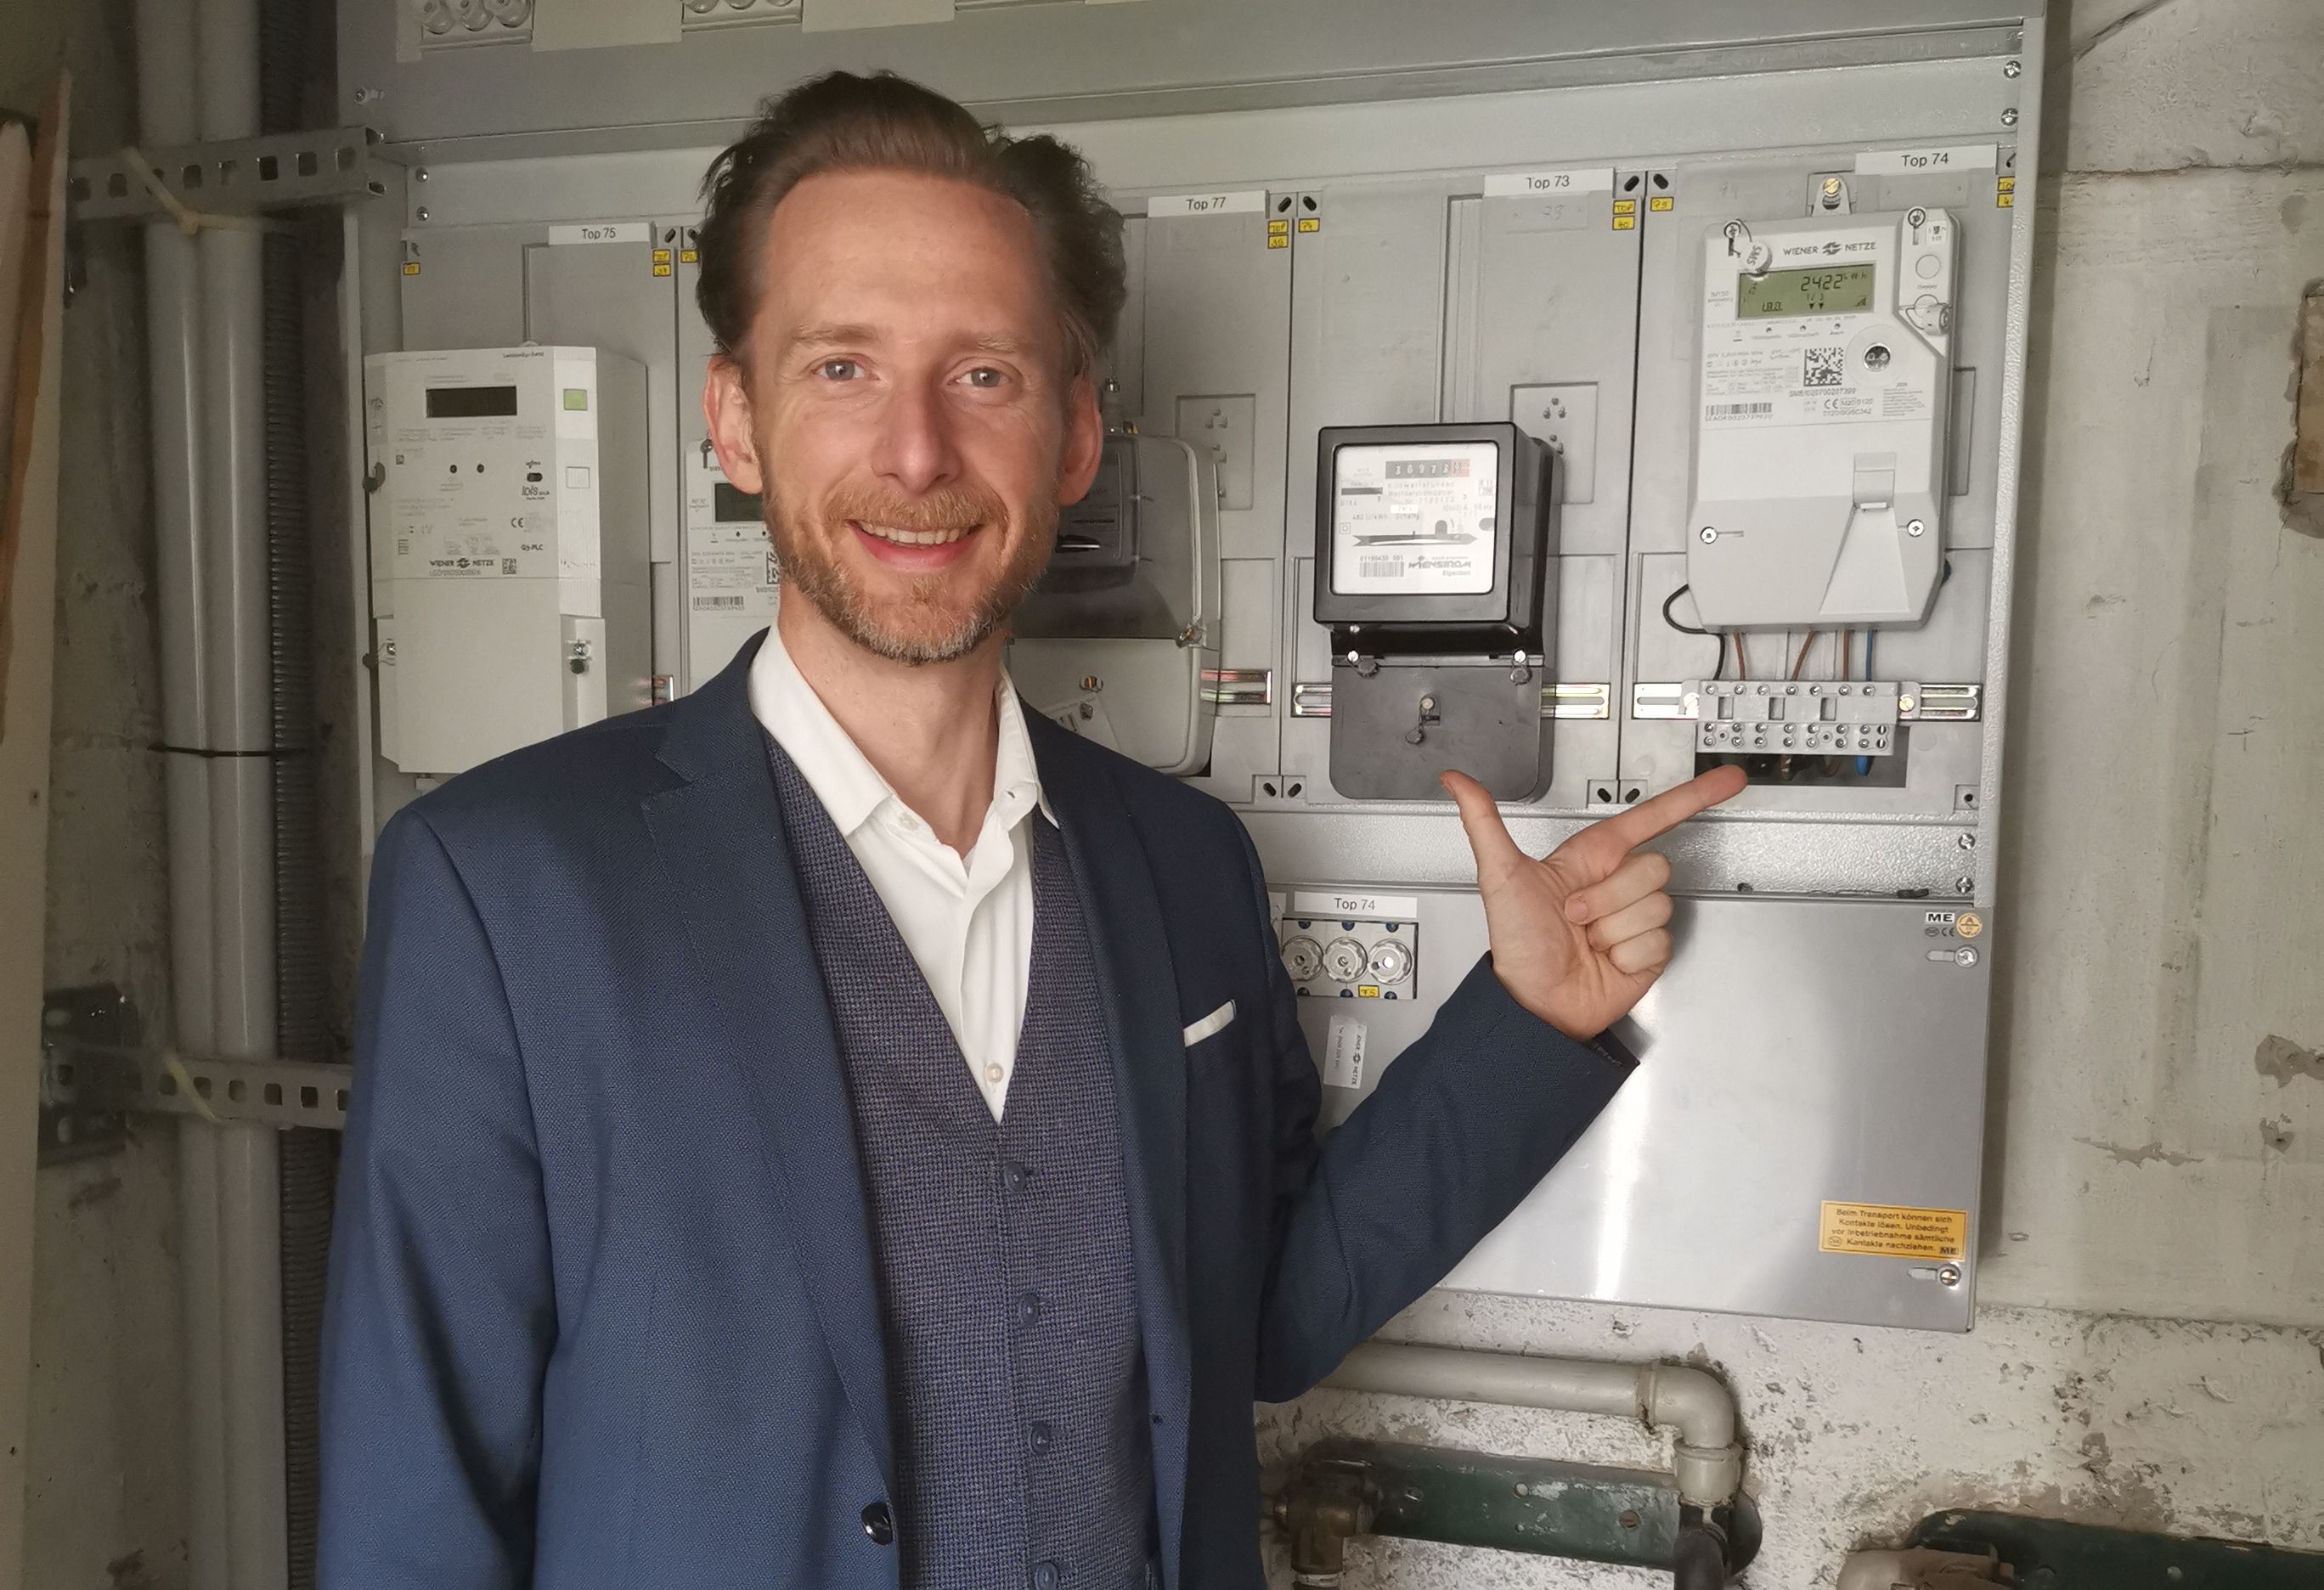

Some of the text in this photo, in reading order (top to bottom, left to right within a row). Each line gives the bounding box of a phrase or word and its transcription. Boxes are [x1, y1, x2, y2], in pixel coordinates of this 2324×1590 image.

[1901, 152, 1949, 168] Top 74
[1526, 175, 1570, 189] Top 73
[1186, 197, 1226, 211] Top 77
[581, 228, 616, 240] Top 75
[1783, 242, 1876, 256] WIENER NETZE
[1801, 274, 1843, 291] 2422
[1334, 898, 1375, 911] Top 74
[1928, 914, 1953, 922] ME
[1860, 1210, 1900, 1221] Transport
[1902, 1213, 1932, 1221] können
[1905, 1223, 1949, 1234] Unbedingt
